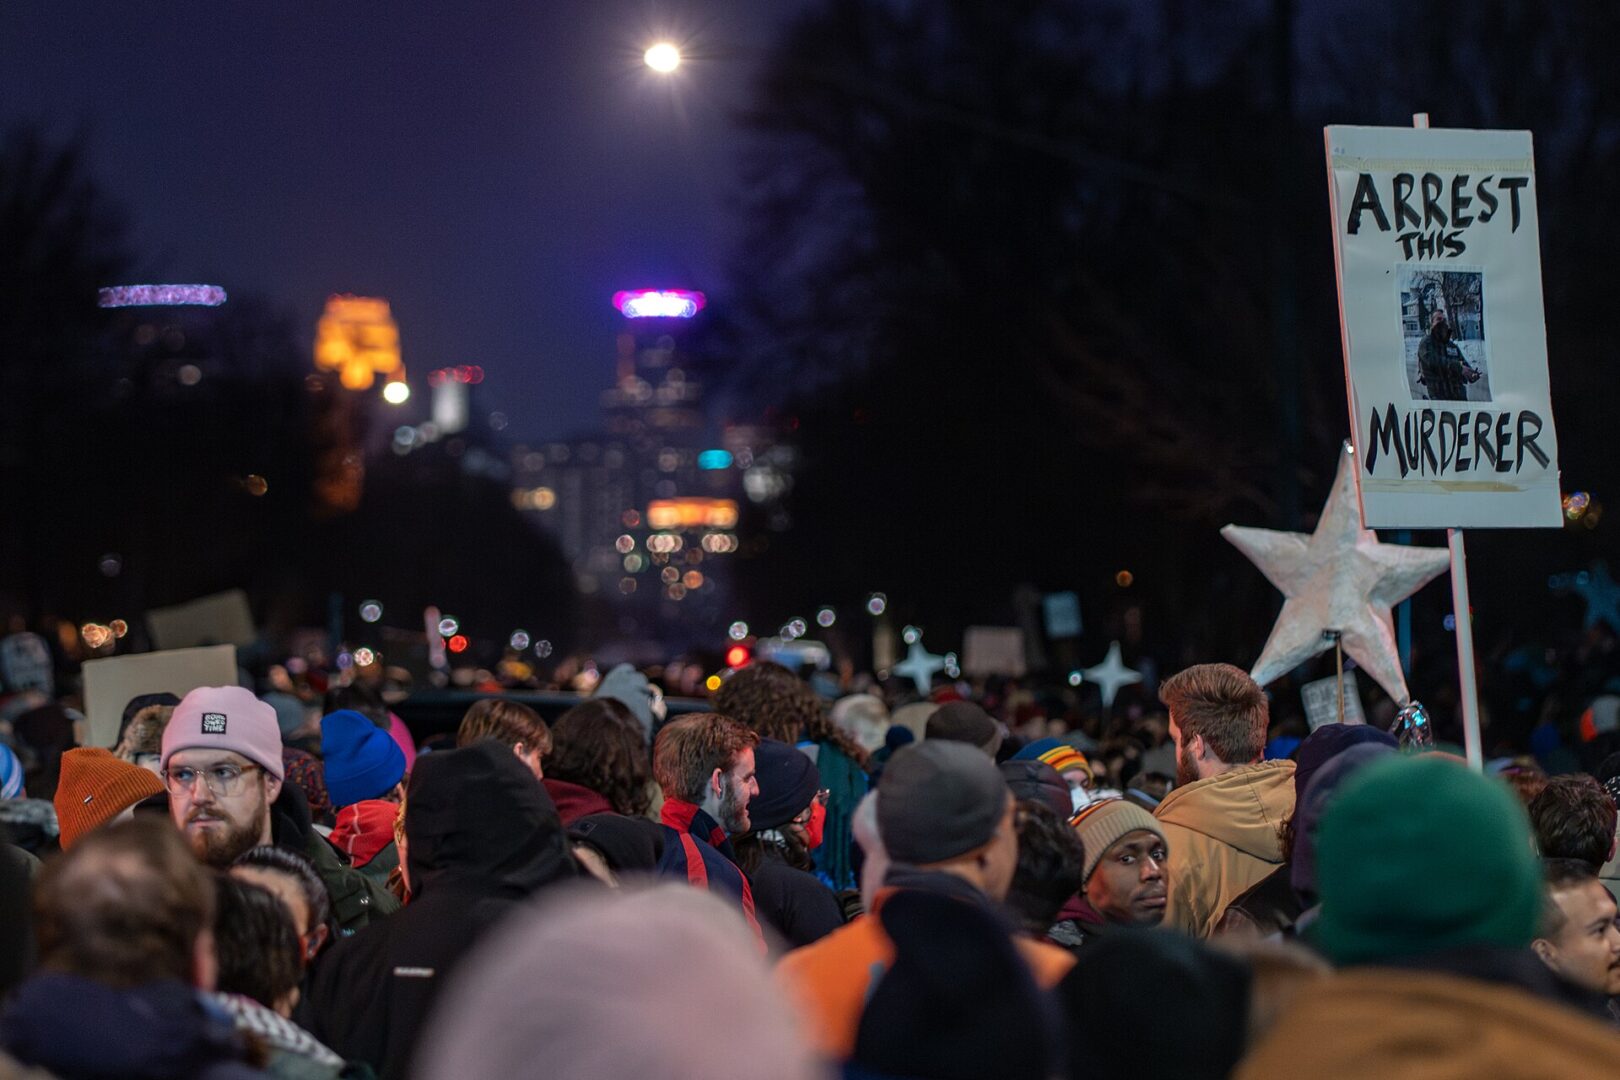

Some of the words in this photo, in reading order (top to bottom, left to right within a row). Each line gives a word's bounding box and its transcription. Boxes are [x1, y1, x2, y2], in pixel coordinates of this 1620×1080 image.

[1347, 173, 1529, 234] ARREST
[1395, 230, 1466, 261] THIS
[1366, 402, 1550, 479] MURDERER
[203, 724, 224, 732] TIME
